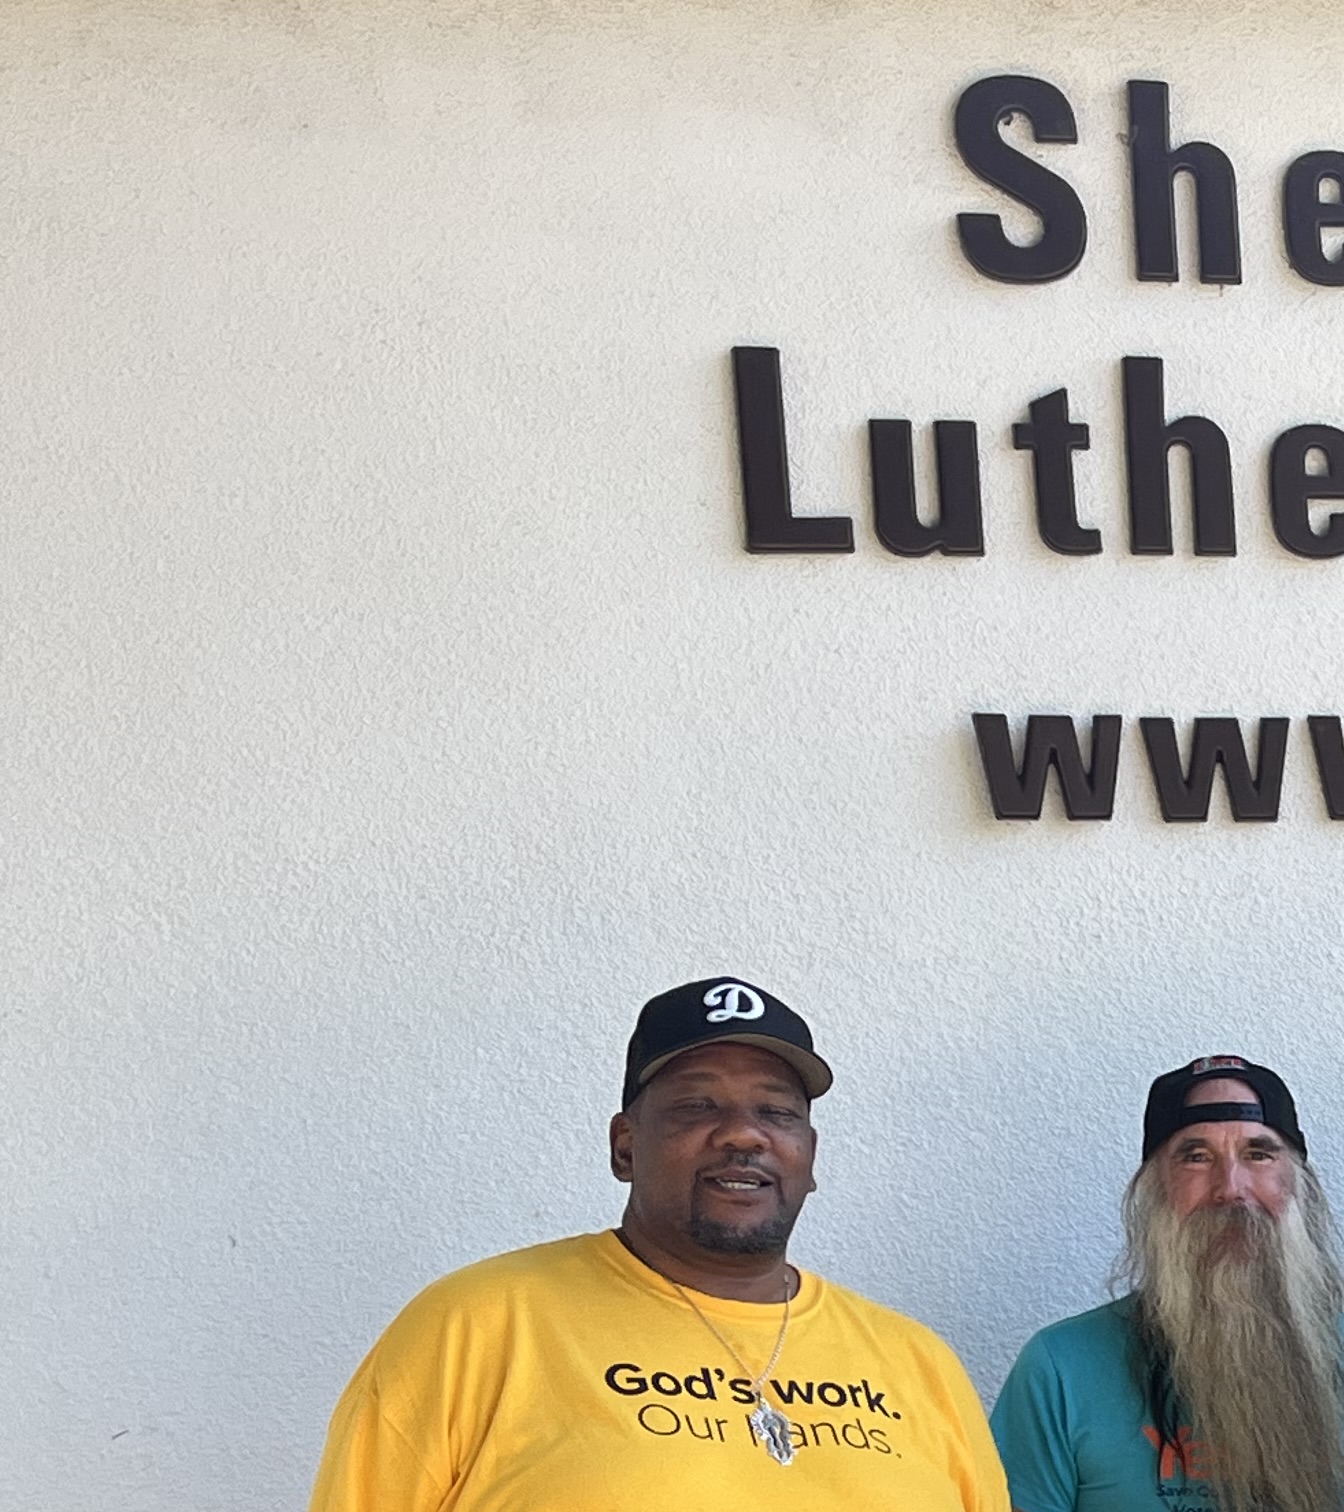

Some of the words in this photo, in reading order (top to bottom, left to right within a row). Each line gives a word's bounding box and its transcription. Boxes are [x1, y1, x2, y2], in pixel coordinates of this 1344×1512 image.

[703, 982, 765, 1023] D
[604, 1363, 757, 1405] God's
[770, 1378, 901, 1420] work.
[638, 1403, 728, 1443] Our
